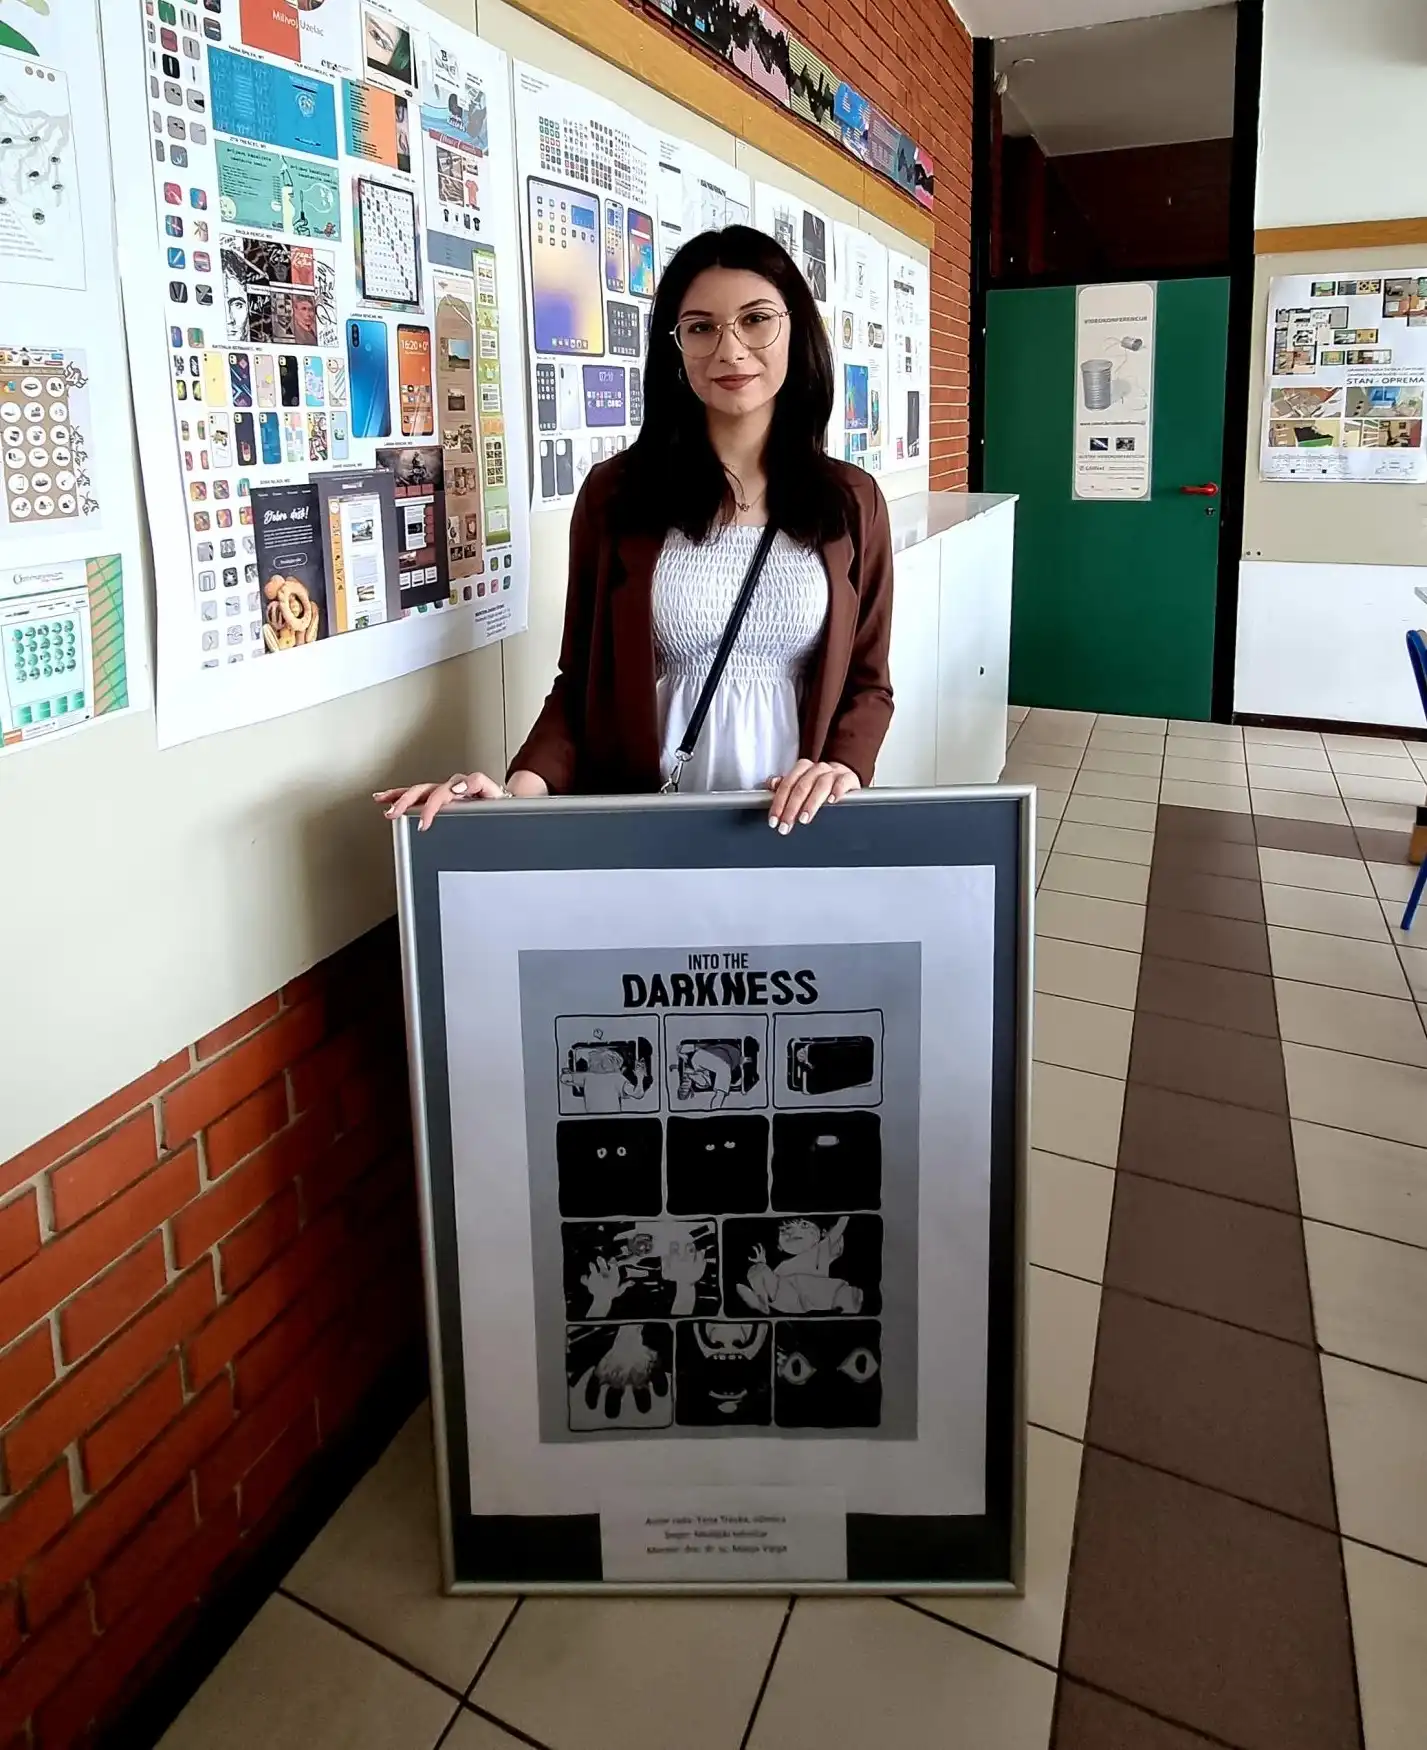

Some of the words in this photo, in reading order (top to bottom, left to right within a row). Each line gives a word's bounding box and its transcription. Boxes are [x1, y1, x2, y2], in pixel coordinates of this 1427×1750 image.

[1346, 377, 1374, 385] STAN
[1381, 376, 1426, 384] OPREMA
[688, 953, 720, 971] INTO
[722, 952, 749, 970] THE
[621, 969, 819, 1008] DARKNESS
